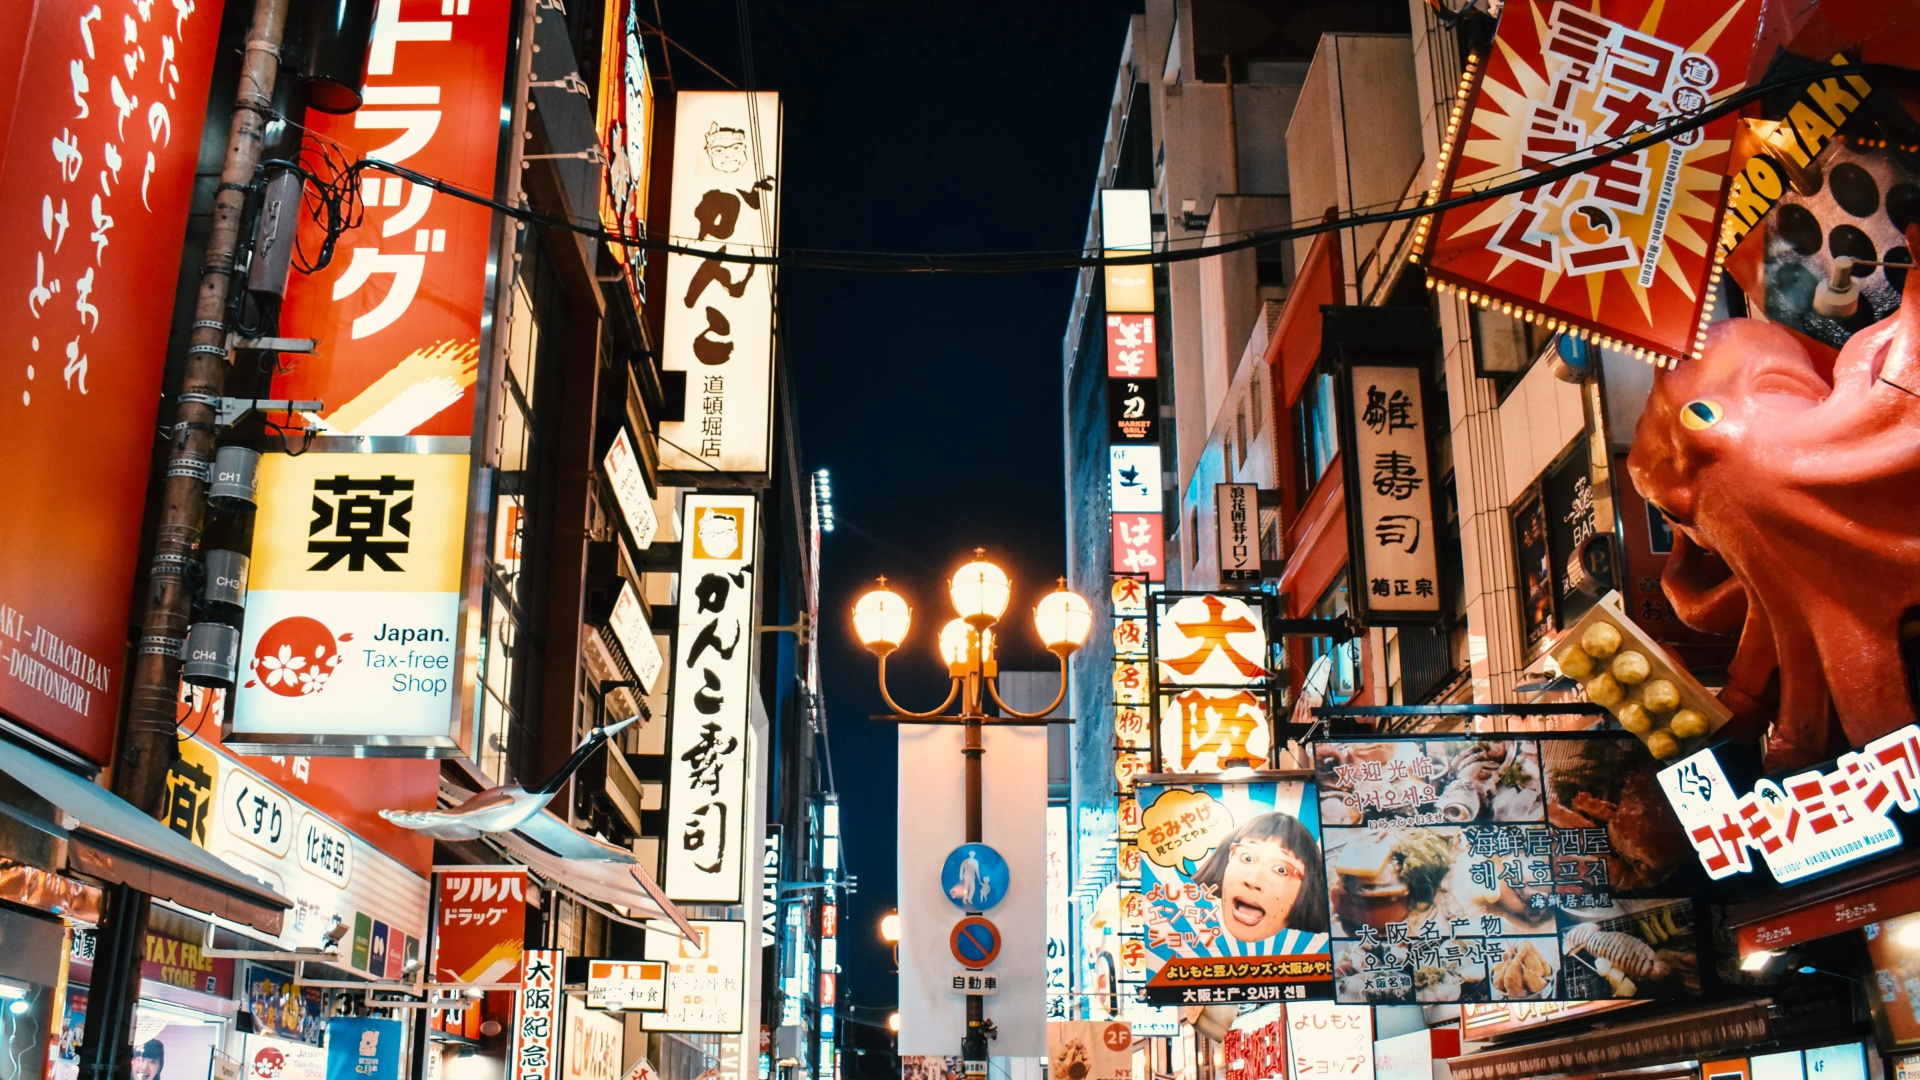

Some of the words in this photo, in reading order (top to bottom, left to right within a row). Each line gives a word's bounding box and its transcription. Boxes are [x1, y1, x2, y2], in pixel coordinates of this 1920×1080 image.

[333, 0, 471, 340] ドラッグ
[1716, 157, 1783, 258] AKO
[684, 175, 776, 365] がんこ
[700, 375, 724, 458] 道頓堀店
[1113, 450, 1126, 460] 6F
[306, 475, 415, 573] 薬
[1230, 486, 1248, 569] 浪花囲碁サロン
[1573, 512, 1597, 548] BAR
[374, 623, 450, 646] Japan.
[192, 649, 217, 661] CH4
[363, 649, 449, 670] Tax-free
[392, 673, 447, 697] Shop
[1343, 784, 1440, 812] 어서오세요
[236, 786, 282, 844] くすり
[1147, 801, 1212, 846] おみやげ
[1368, 812, 1445, 830] いらっしゃいませ
[306, 825, 346, 879] 化粧品
[1469, 859, 1610, 890] 해선호프집
[446, 877, 523, 903] ツルハ
[1146, 882, 1219, 901] よしもと
[444, 907, 508, 926] ドラッグ
[1148, 904, 1220, 925] エンタメ
[1148, 927, 1221, 948] ショップ
[146, 935, 177, 966] TAX
[181, 942, 213, 972] FREE
[161, 966, 196, 989] STORE
[953, 976, 997, 990] 自動車
[1363, 976, 1412, 990] 大阪名物
[1294, 1013, 1361, 1030] よしもと
[1106, 1031, 1128, 1044] 2F
[1297, 1054, 1366, 1075] ショップ
[1814, 1060, 1825, 1074] 4F
